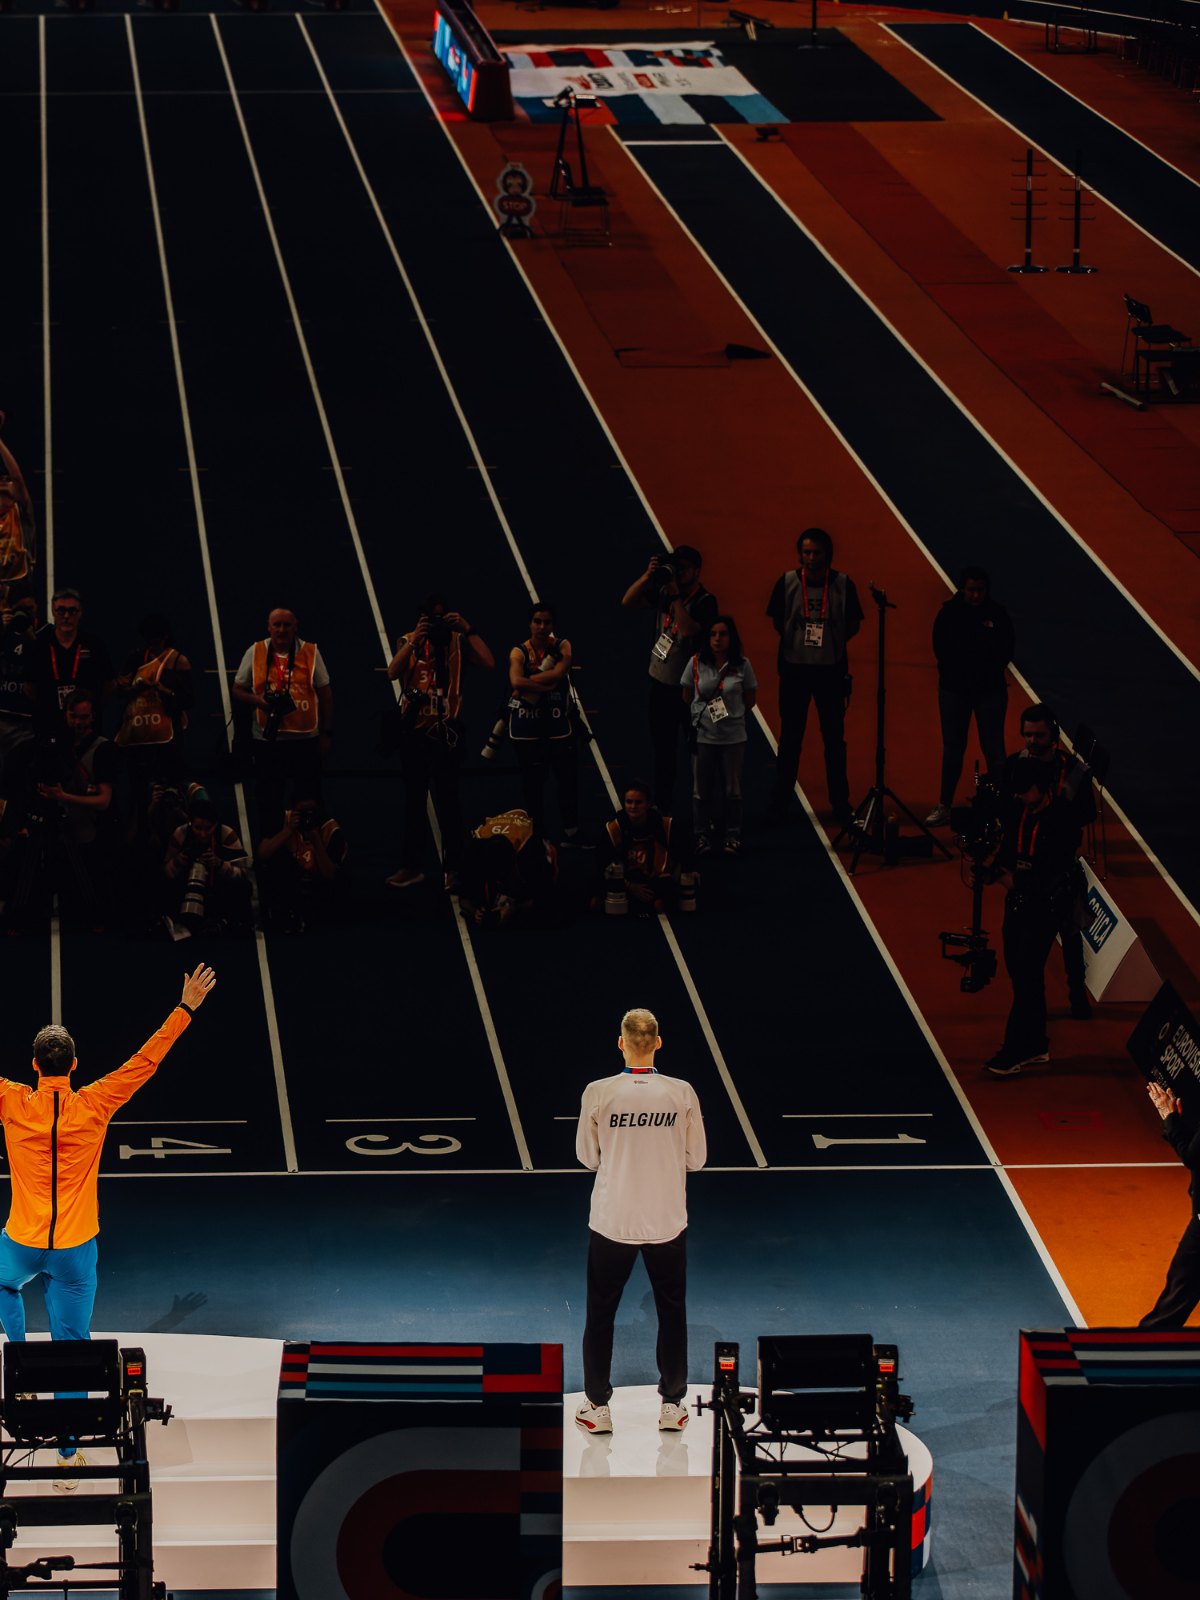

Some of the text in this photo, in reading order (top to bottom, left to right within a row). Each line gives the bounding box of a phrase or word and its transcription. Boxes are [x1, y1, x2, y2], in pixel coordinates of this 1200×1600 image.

[502, 201, 527, 210] STOP
[13, 643, 24, 656] 4
[1160, 1043, 1185, 1081] SPORT
[1172, 1024, 1200, 1084] EUROVISIO
[609, 1112, 677, 1128] BELGIUM
[119, 1137, 232, 1160] 4
[345, 1133, 462, 1156] 3
